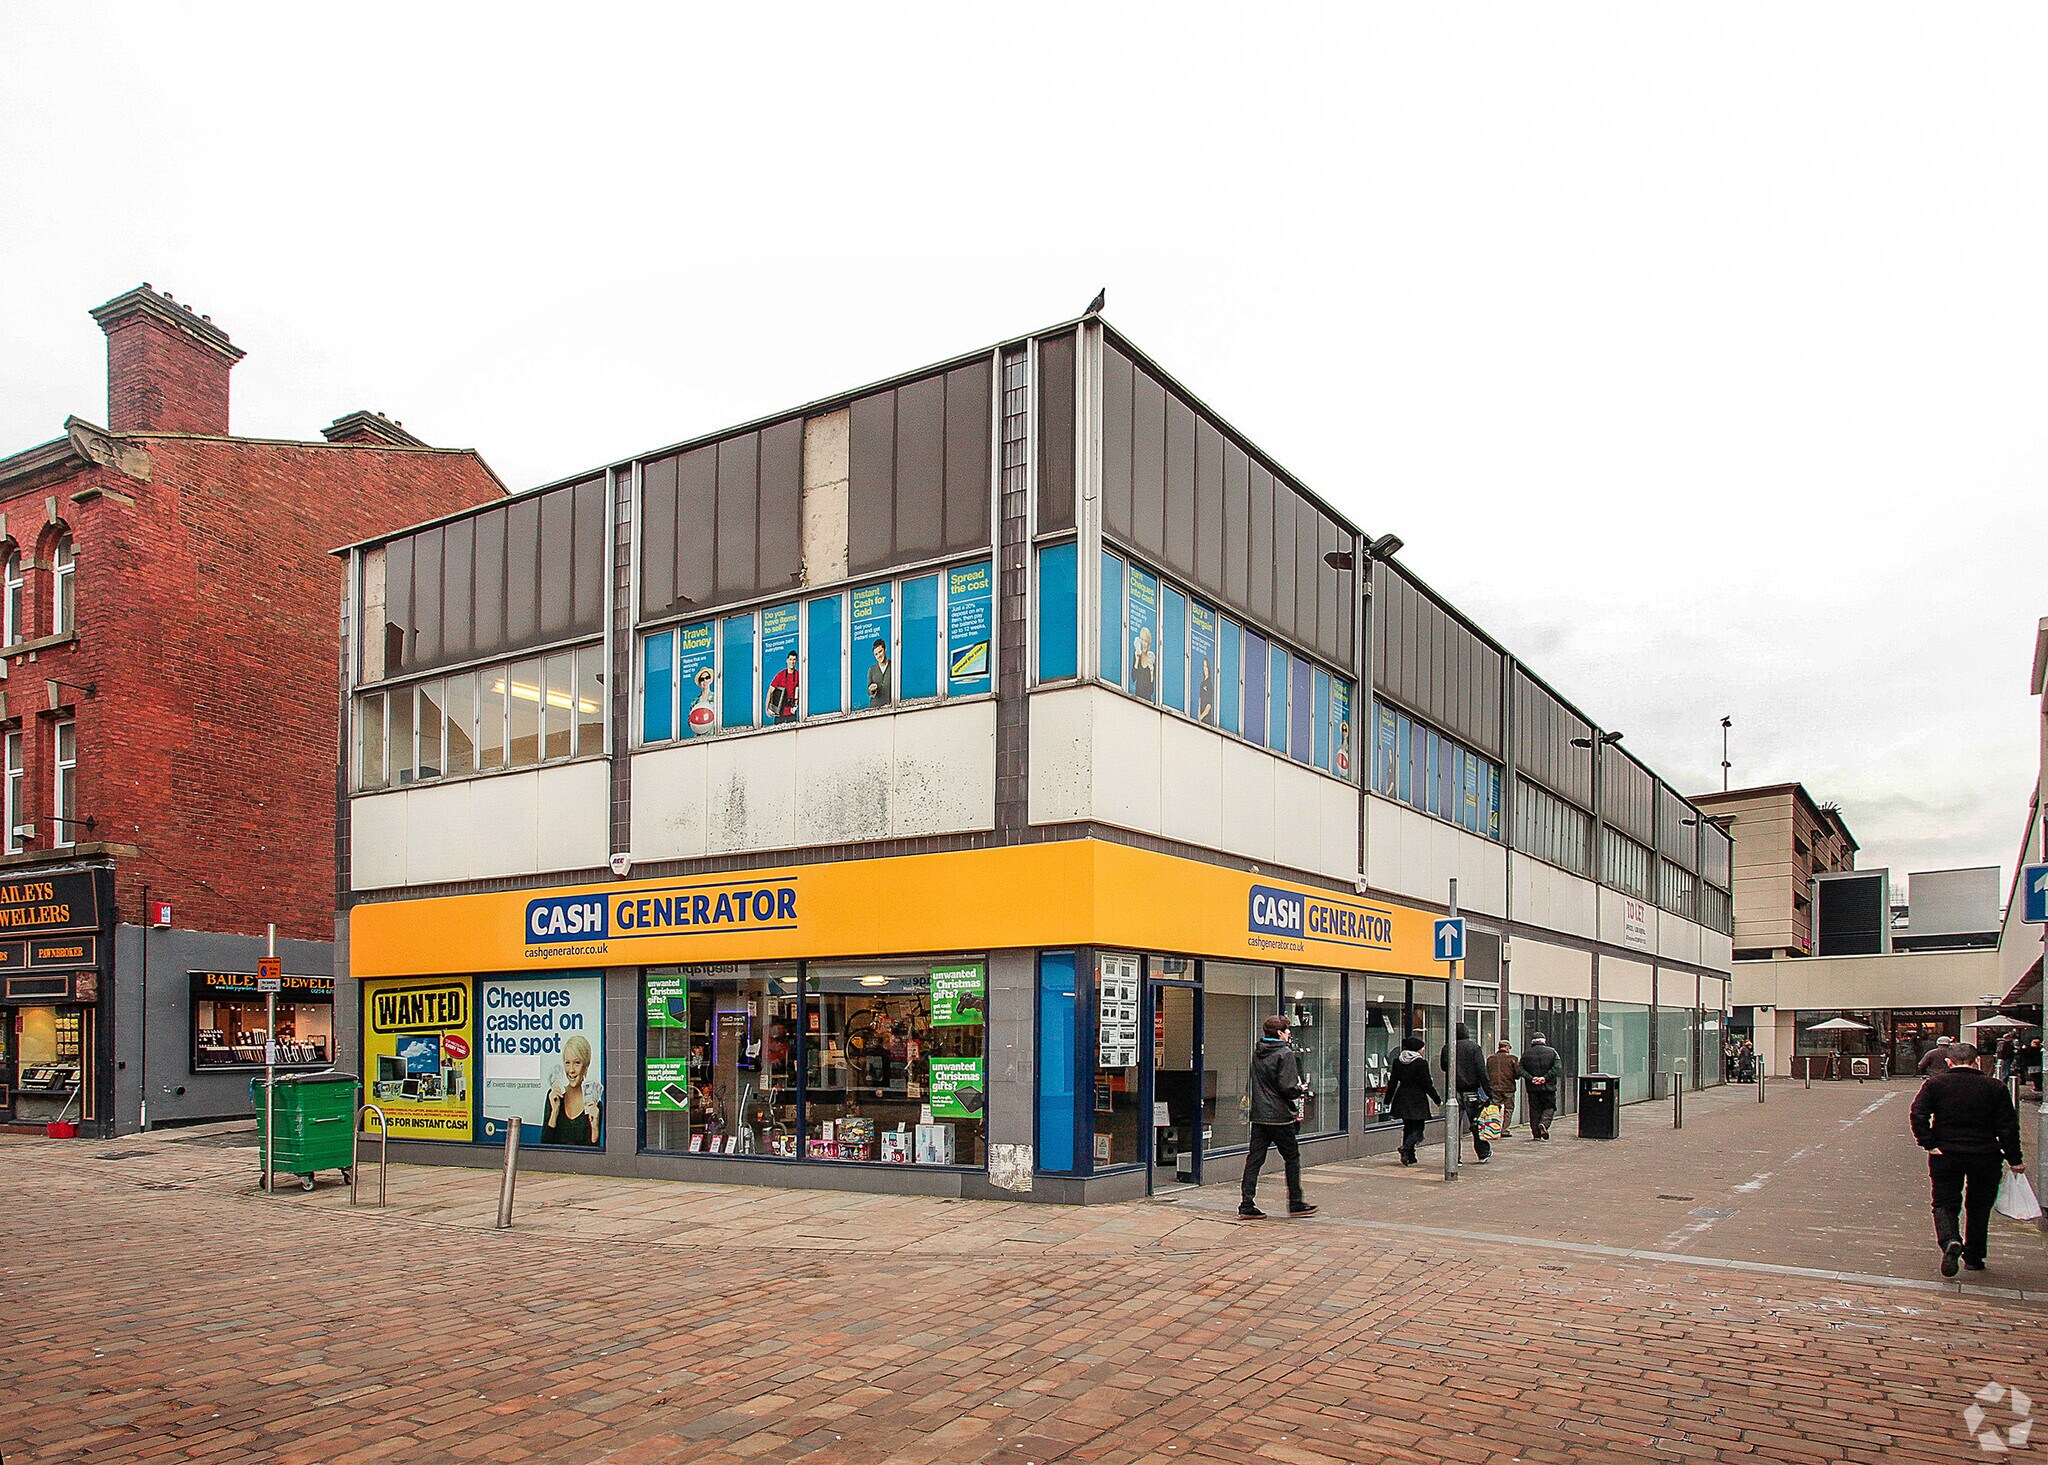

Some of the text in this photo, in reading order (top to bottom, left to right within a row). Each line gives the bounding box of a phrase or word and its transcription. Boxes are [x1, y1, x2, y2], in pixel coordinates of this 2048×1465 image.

[951, 569, 985, 586] Spread
[951, 579, 989, 595] the cost
[854, 588, 880, 600] Instant
[854, 596, 886, 609] Cash for
[765, 610, 786, 620] Do you
[854, 607, 872, 618] Gold
[1192, 605, 1203, 619] Buy
[765, 614, 797, 627] have items
[1192, 614, 1213, 632] bargain
[683, 627, 708, 640] Travel
[683, 637, 711, 650] Money
[531, 888, 798, 936] CASH GENERATOR
[1252, 894, 1392, 943] CASH GENERATOR
[1247, 936, 1304, 952] cashgenerator.co.uk
[38, 946, 83, 959] PAWNBROKER
[525, 943, 608, 960] cashgenerator.co.uk
[206, 973, 258, 986] BAILE
[932, 968, 977, 980] unwanted
[647, 978, 680, 987] unwanted
[936, 979, 981, 989] Christmas
[650, 987, 683, 995] Christmas
[933, 989, 959, 1001] gifts?
[486, 987, 571, 1012] Cheques
[647, 995, 666, 1006] gifts?
[378, 991, 460, 1025] WANTED
[486, 1008, 583, 1031] cashed on
[486, 1032, 561, 1055] the spot
[932, 1061, 976, 1071] unwanted
[935, 1071, 980, 1081] Christmas
[932, 1081, 958, 1092] gifts?
[395, 1118, 410, 1127] FOR
[411, 1119, 445, 1128] INSTANT
[446, 1120, 468, 1130] CASH
